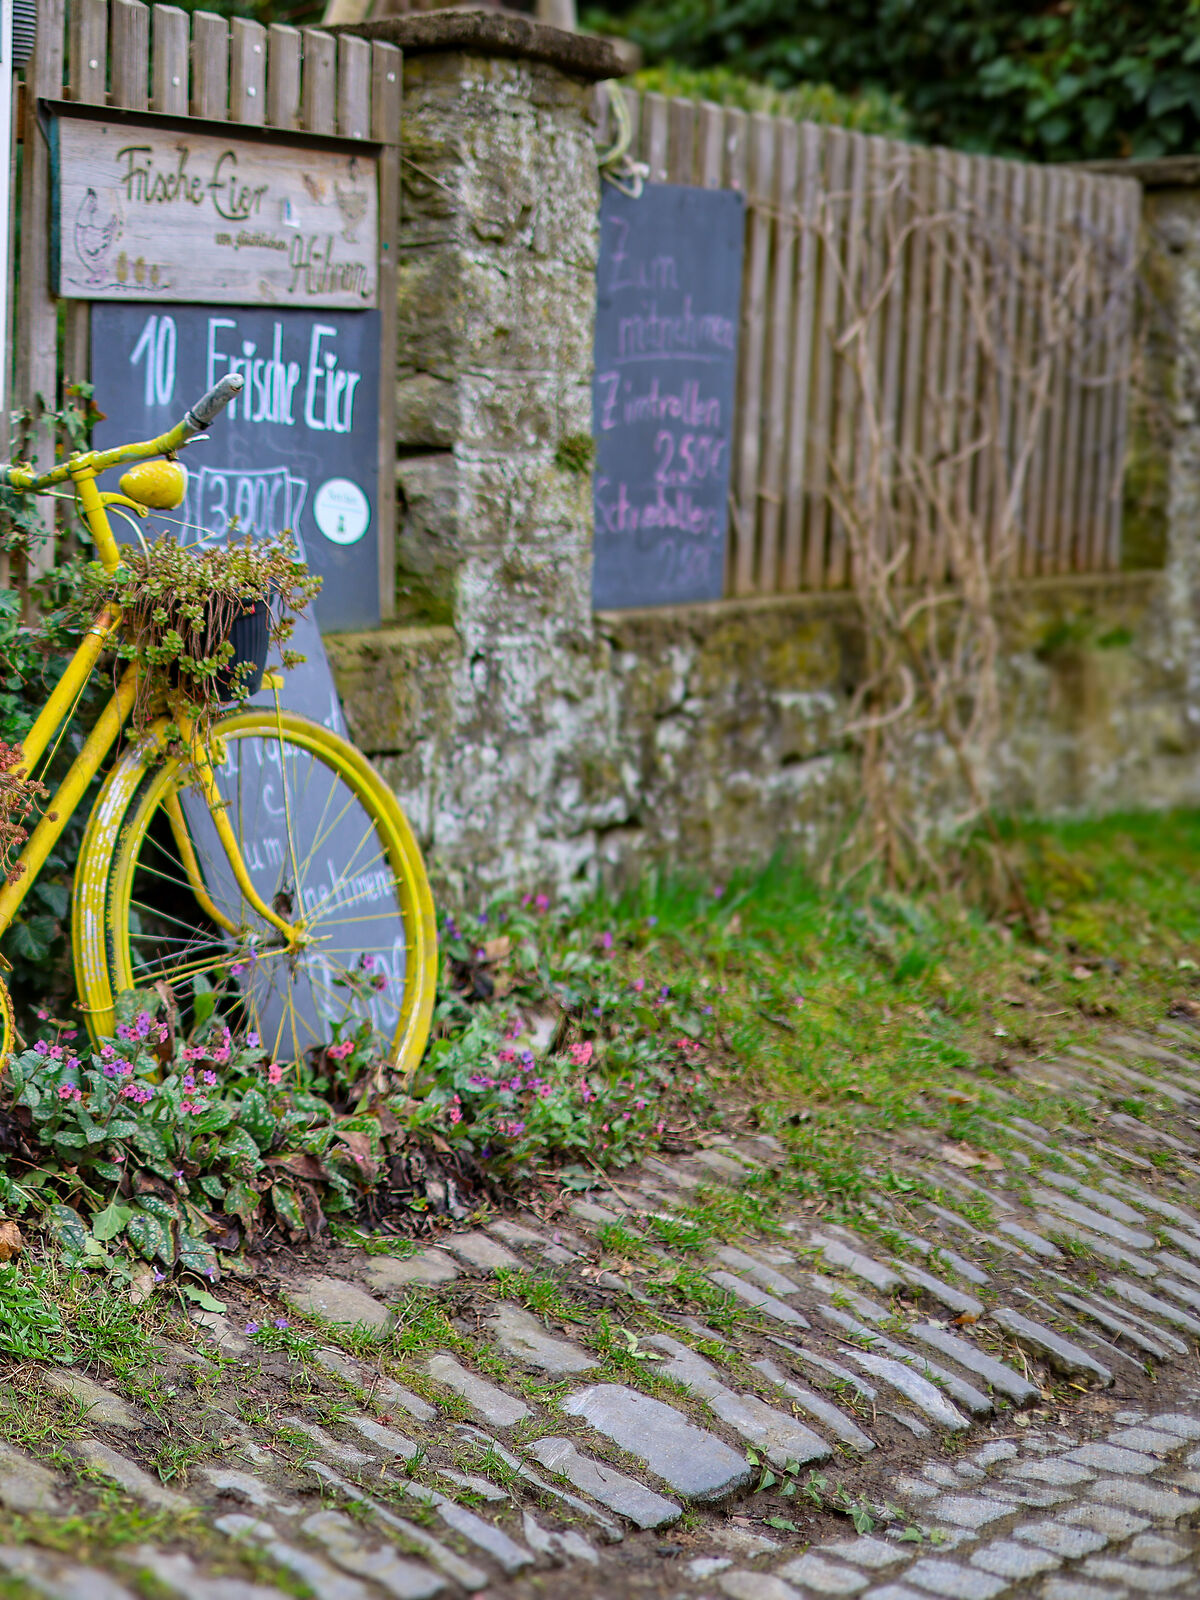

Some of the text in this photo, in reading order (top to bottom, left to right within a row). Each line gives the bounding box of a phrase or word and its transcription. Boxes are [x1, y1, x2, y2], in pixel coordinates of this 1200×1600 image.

[115, 145, 269, 221] Frische Eier
[129, 314, 361, 433] 10 Frische Eier
